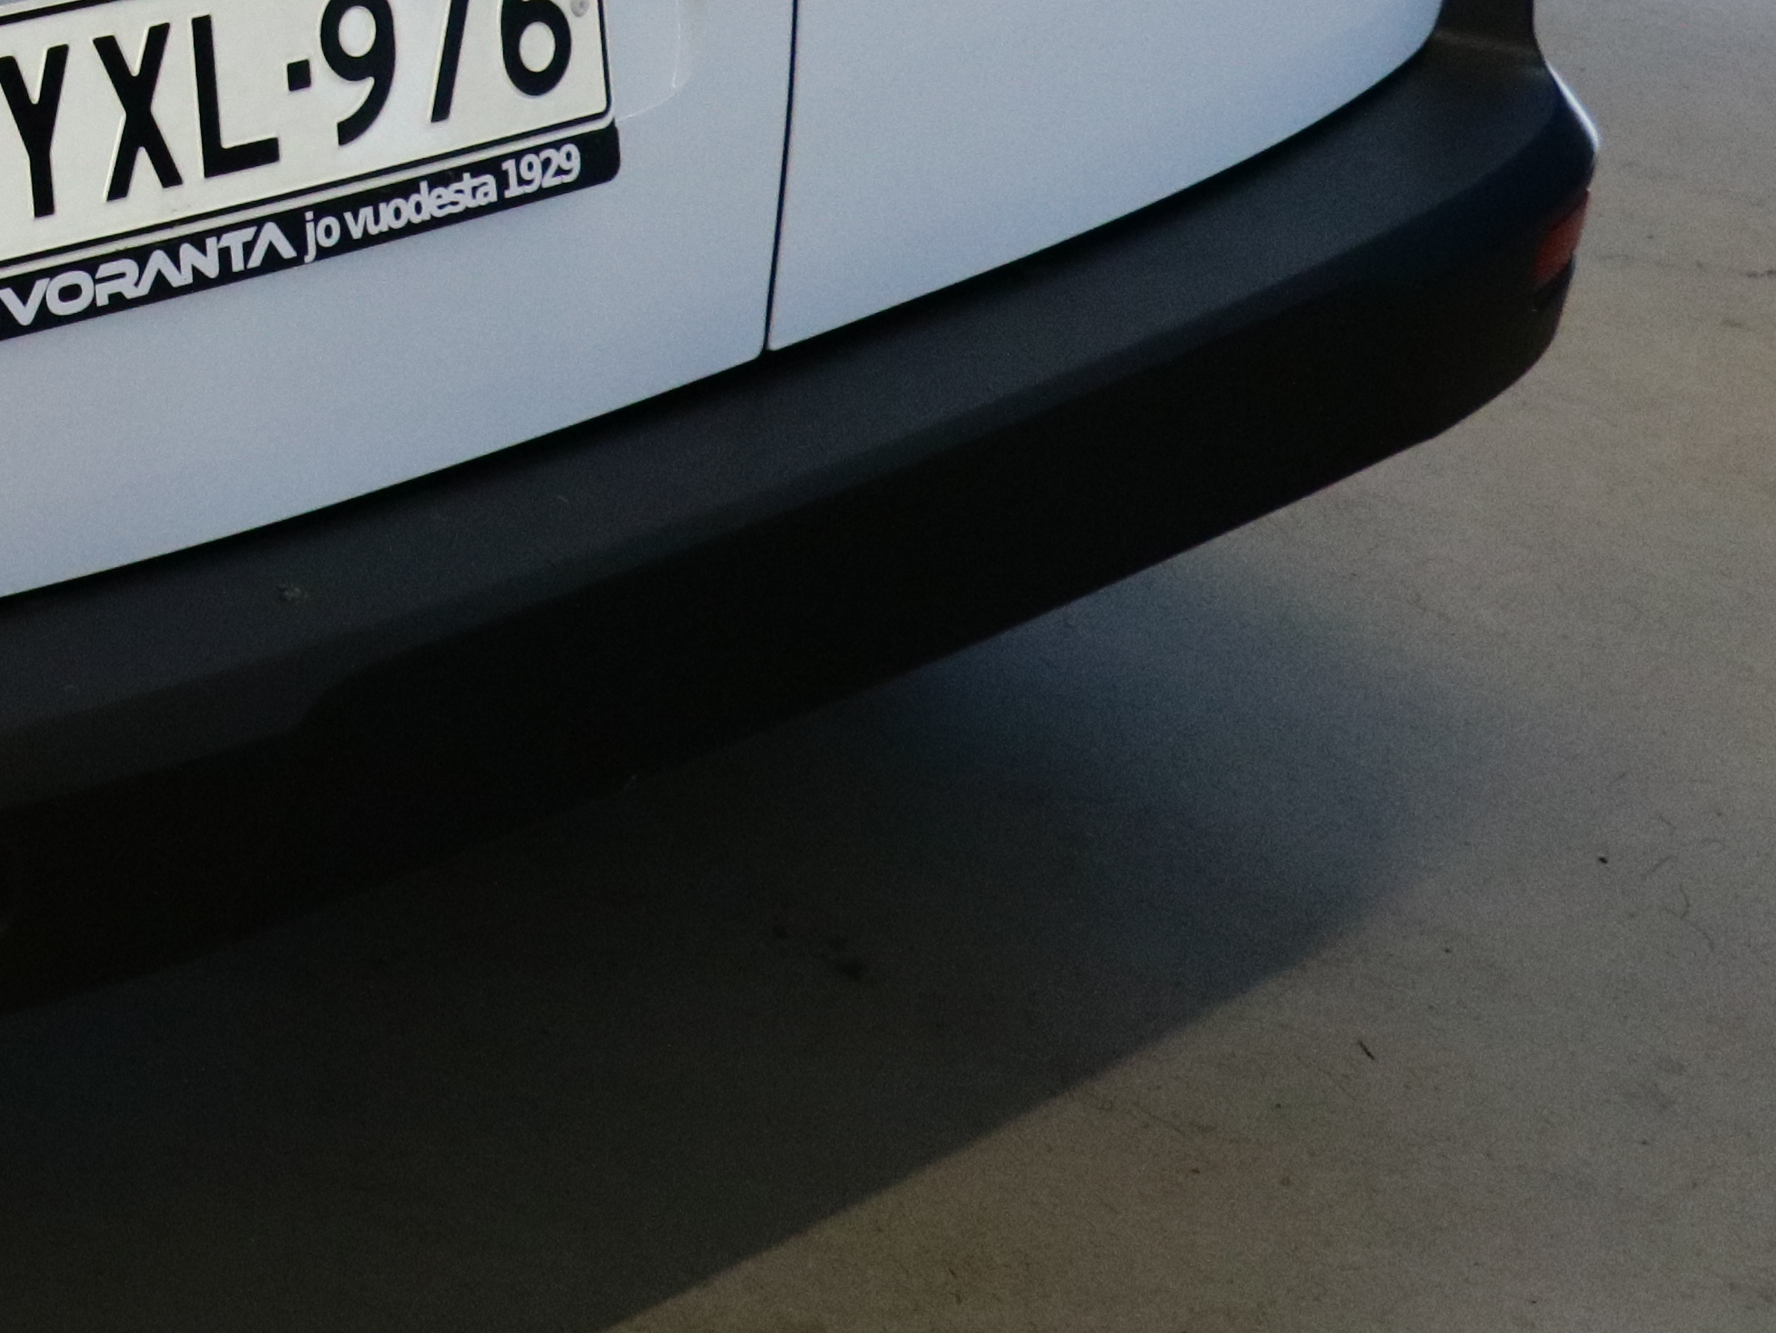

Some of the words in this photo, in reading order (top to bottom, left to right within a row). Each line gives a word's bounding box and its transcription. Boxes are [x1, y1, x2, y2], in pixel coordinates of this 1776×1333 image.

[303, 211, 341, 263] jo
[344, 172, 497, 239] vuodesta
[501, 143, 581, 198] 1929
